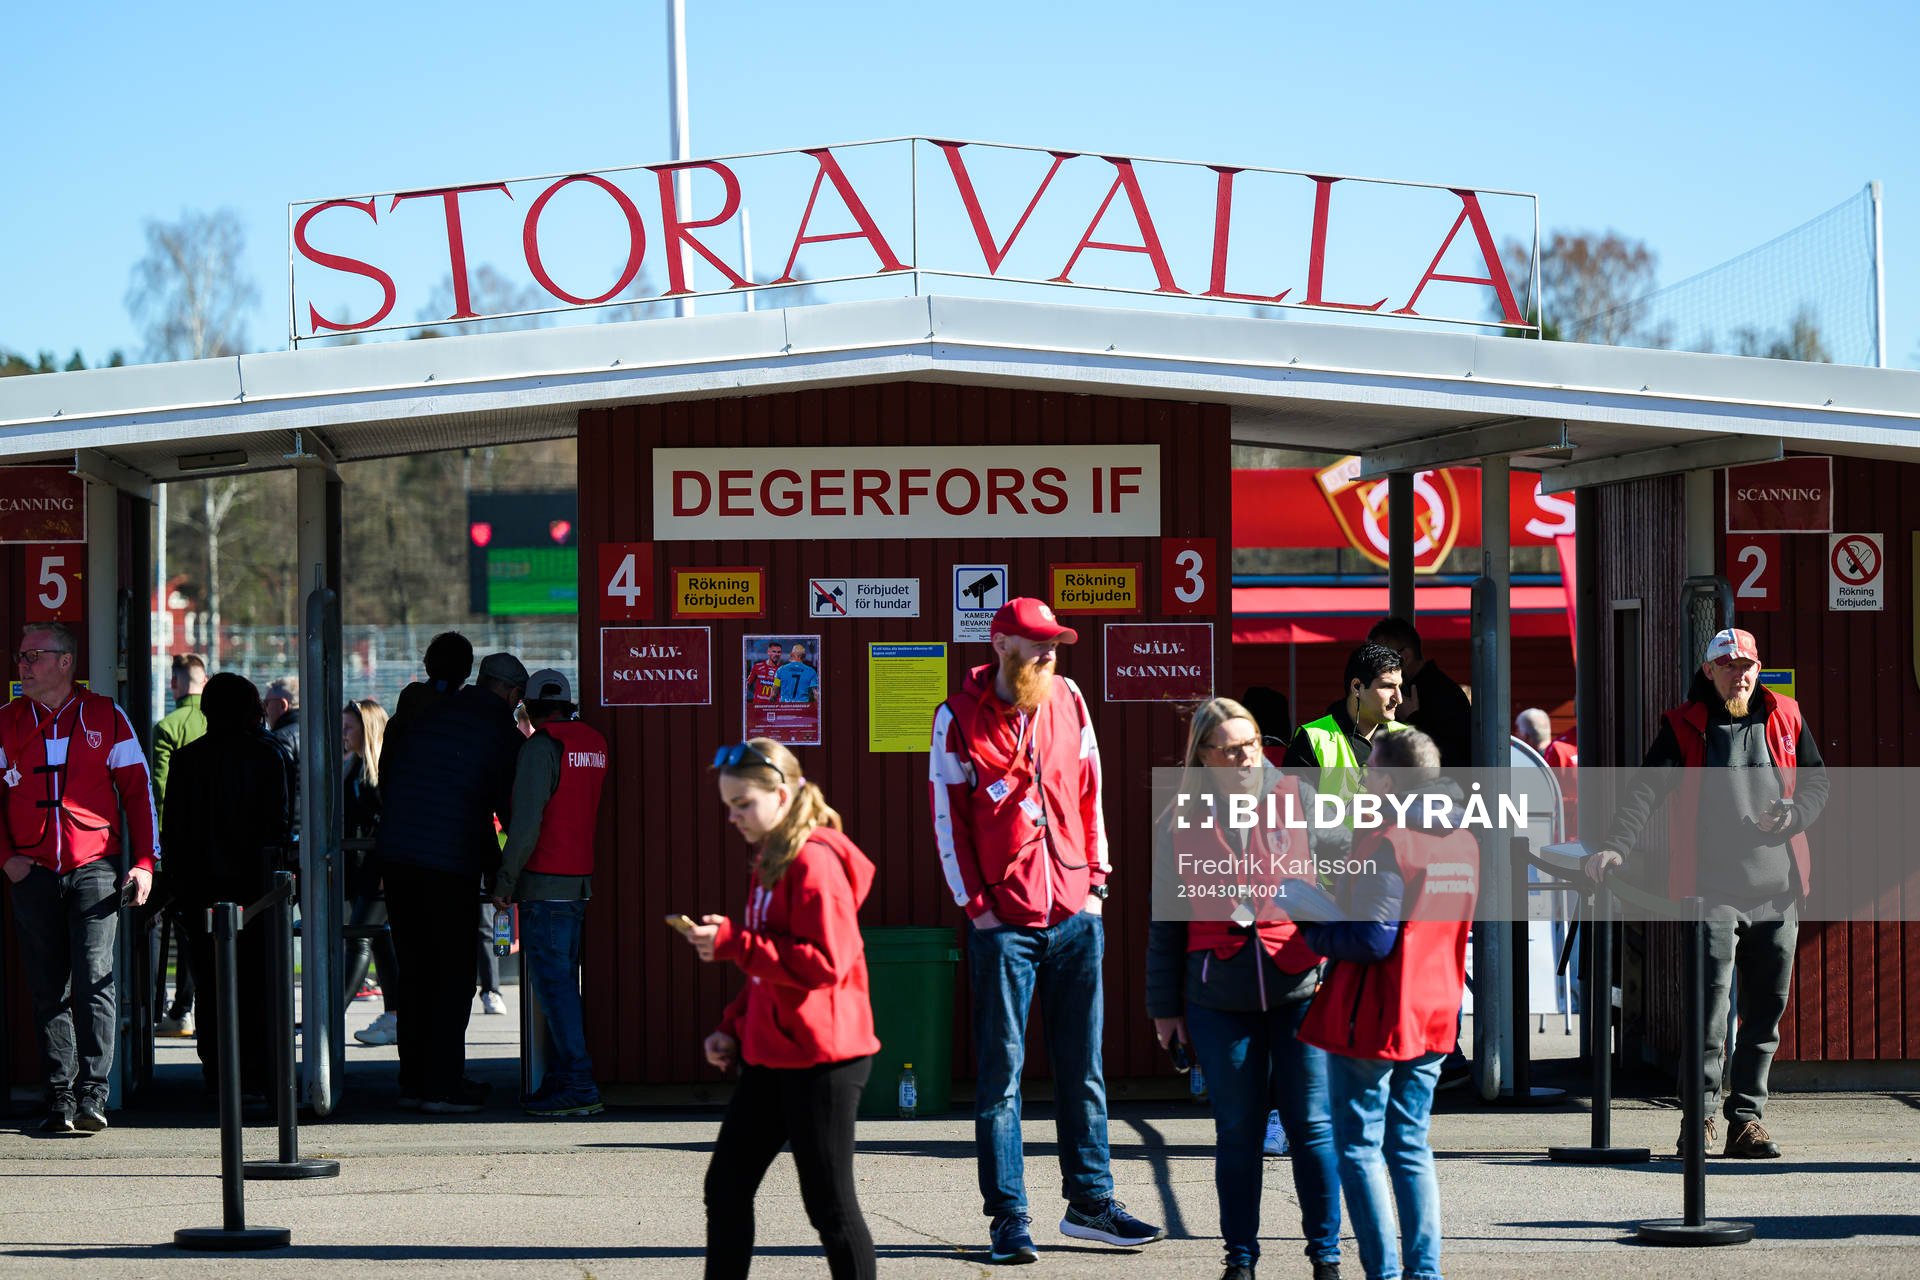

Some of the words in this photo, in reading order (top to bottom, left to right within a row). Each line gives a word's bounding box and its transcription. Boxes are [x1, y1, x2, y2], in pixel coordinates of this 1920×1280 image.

[294, 148, 914, 334] STORA
[928, 139, 1529, 325] VALLA
[672, 467, 1069, 517] DEGERFORS
[1092, 467, 1142, 514] IF
[1737, 488, 1821, 501] SCANNING
[0, 498, 73, 511] CANNING
[1174, 550, 1205, 603] 3
[1737, 545, 1767, 598] 2
[38, 556, 68, 609] 5
[607, 554, 641, 607] 4
[689, 577, 750, 592] Rökning
[1065, 574, 1126, 588] Rökning
[857, 584, 910, 597] Förbjudet
[1061, 589, 1131, 604] förbjuden
[1839, 587, 1875, 597] Rökning
[684, 593, 755, 608] förbjuden
[855, 598, 871, 609] för
[874, 598, 911, 609] hundar
[1836, 598, 1877, 608] förbjuden
[629, 644, 682, 658] SJÄLV-
[1133, 641, 1185, 654] SJÄLV-
[612, 669, 699, 682] SCANNING
[1116, 665, 1201, 677] SCANNING
